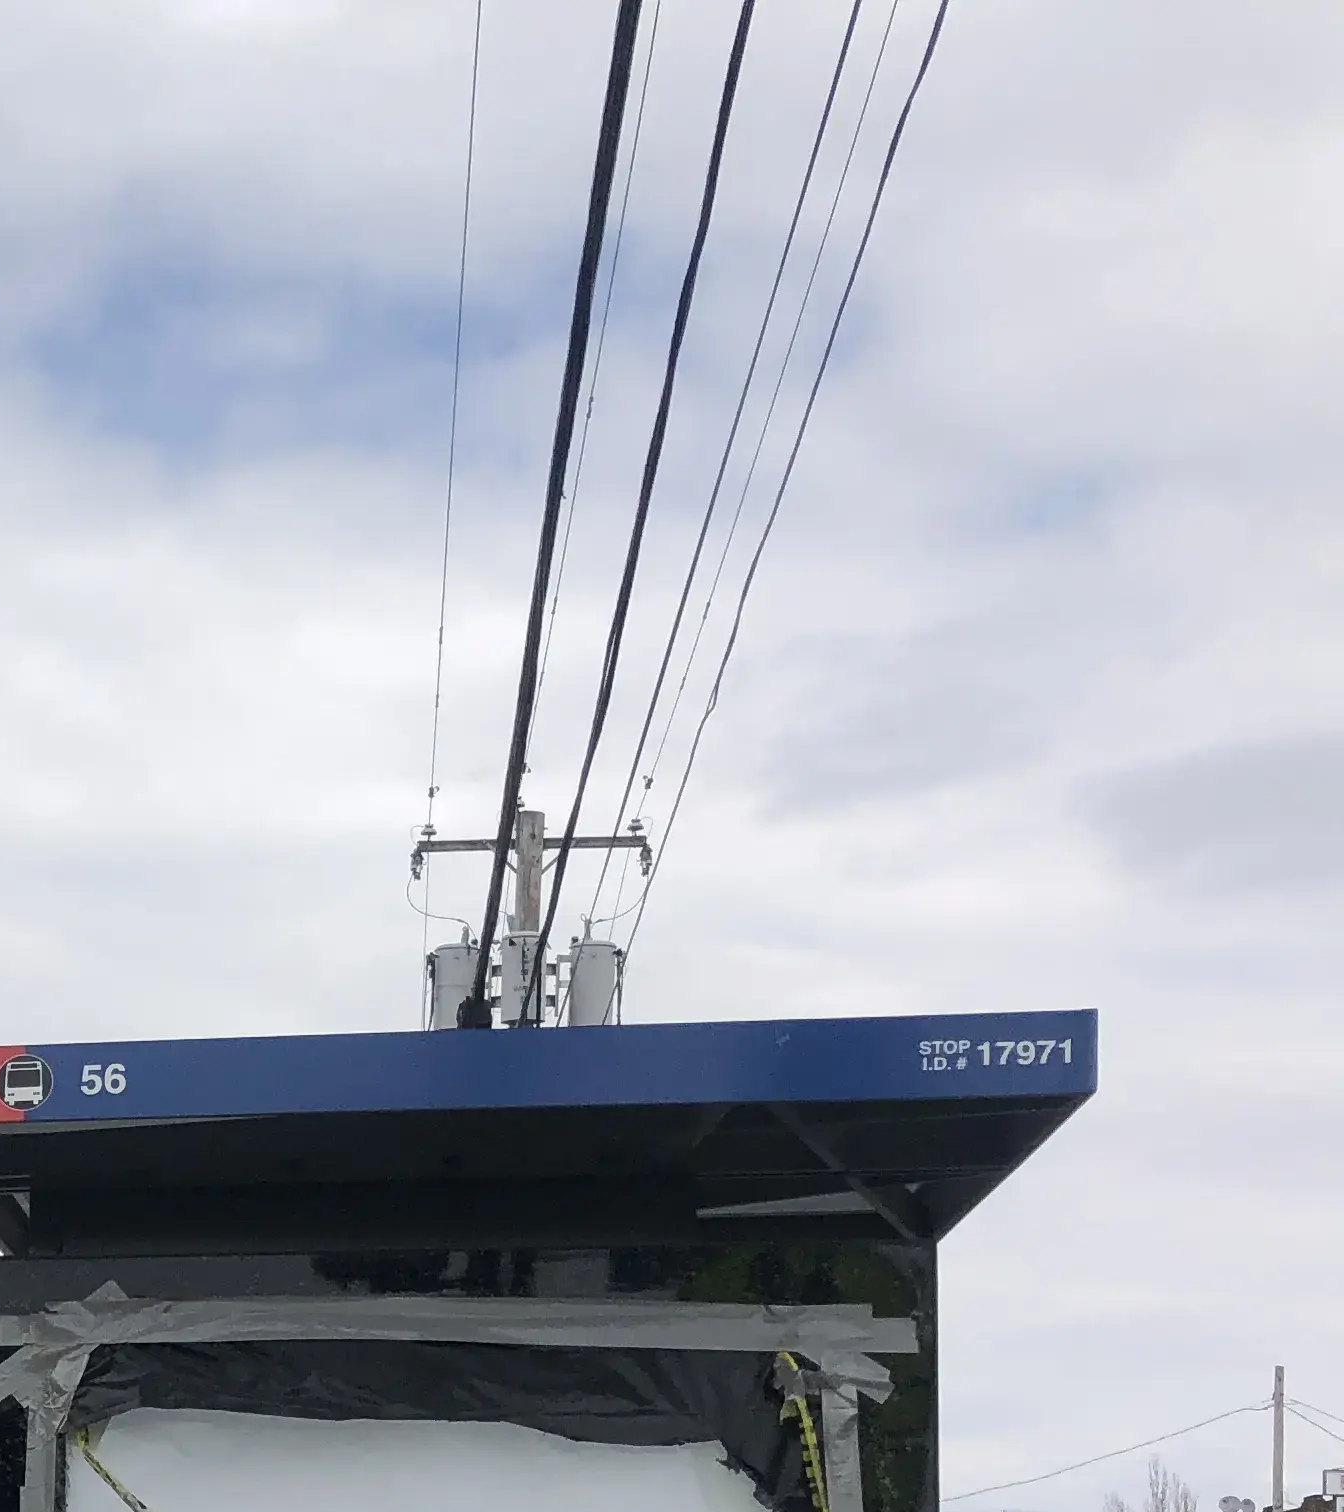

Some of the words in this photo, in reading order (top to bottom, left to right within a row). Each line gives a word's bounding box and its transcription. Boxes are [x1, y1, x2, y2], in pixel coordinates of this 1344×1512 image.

[919, 1040, 971, 1055] STOP
[976, 1038, 1073, 1067] 17971
[921, 1057, 952, 1071] I.D.
[79, 1062, 127, 1096] 56
